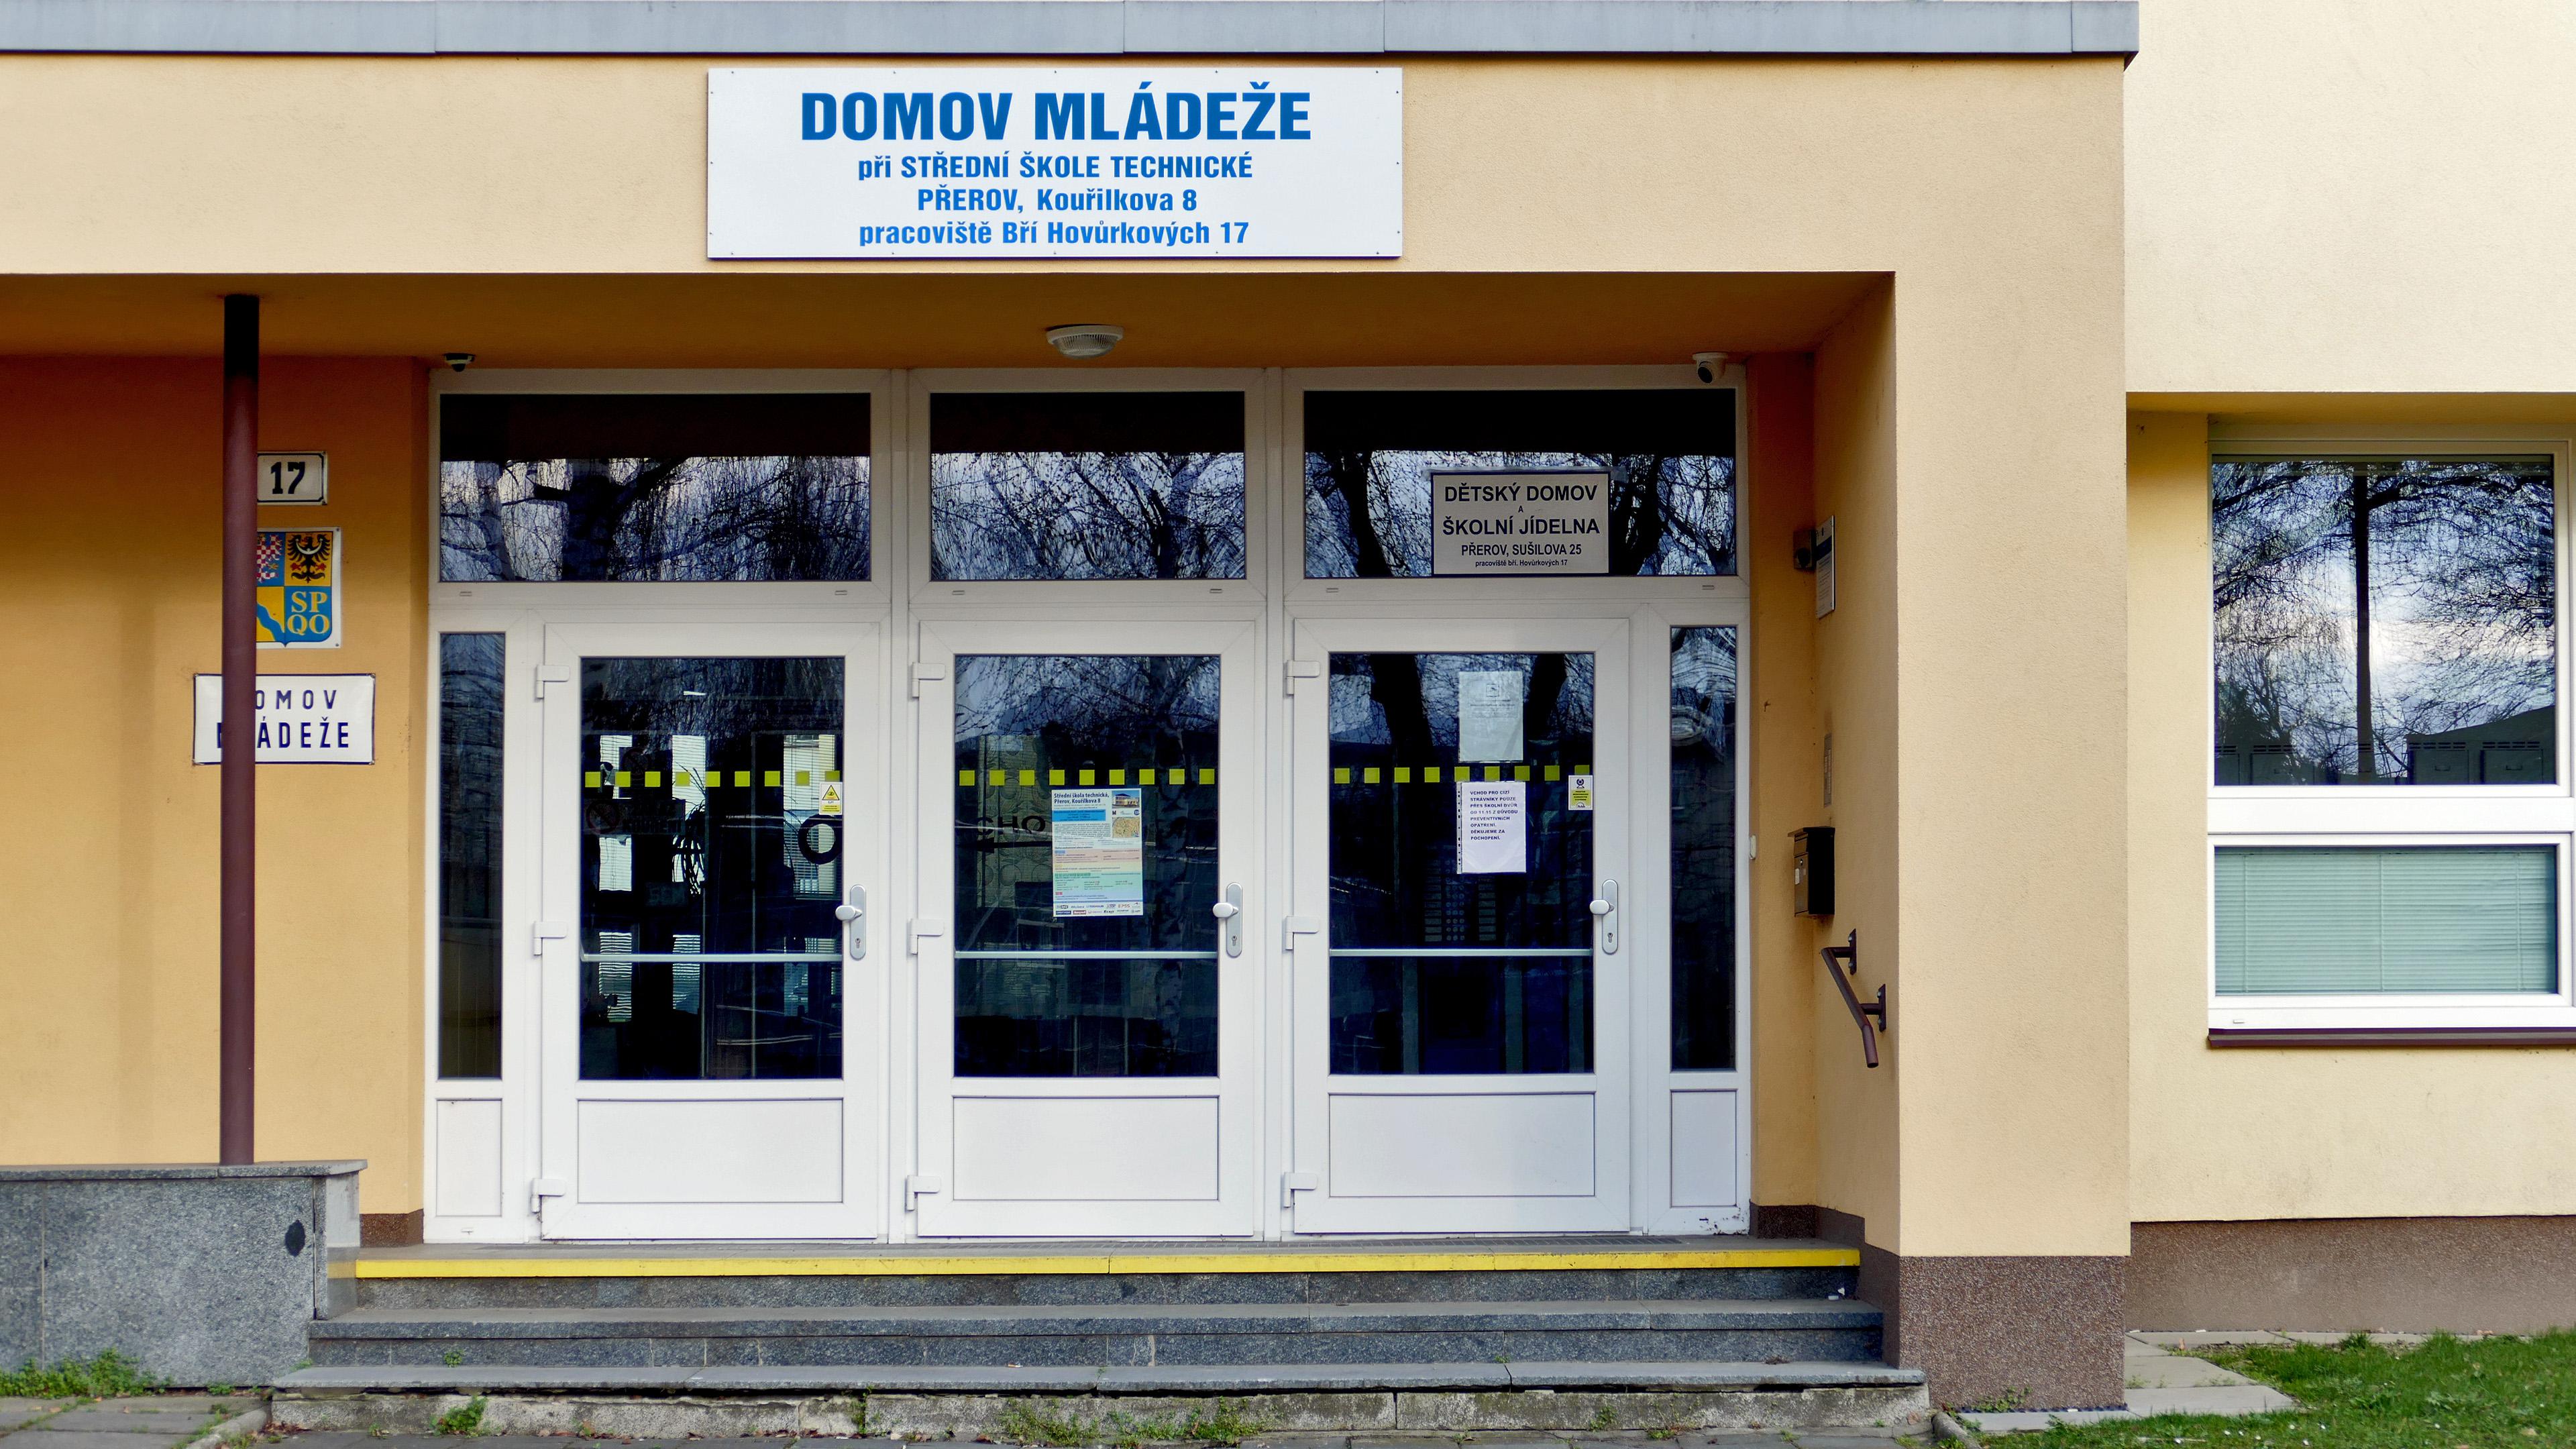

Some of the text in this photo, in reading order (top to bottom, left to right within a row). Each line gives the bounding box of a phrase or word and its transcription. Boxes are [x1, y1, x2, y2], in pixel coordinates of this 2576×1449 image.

[802, 81, 1311, 141] DOMOV MLÁDEŽE
[858, 151, 1252, 181] při STŘEDNÍ ŠKOLE TECHNICKÉ
[918, 184, 1197, 213] PŘEROV, Kouřilkova 8
[859, 220, 1249, 247] pracoviště Bří Hovůrkových 17
[270, 461, 306, 494] 17
[1445, 482, 1598, 502] DĚTSKÝ DOMOV
[1517, 505, 1524, 513] A
[1442, 516, 1601, 535] ŠKOLNÍ JÍDELNA
[1461, 541, 1582, 557] PŘEROV, SUŠILOVA 25
[1519, 559, 1560, 568] Hovůrkových
[291, 591, 328, 612] SP
[287, 614, 329, 636] QO
[256, 689, 337, 710] OMOV
[217, 716, 350, 749] ÁDEŽE
